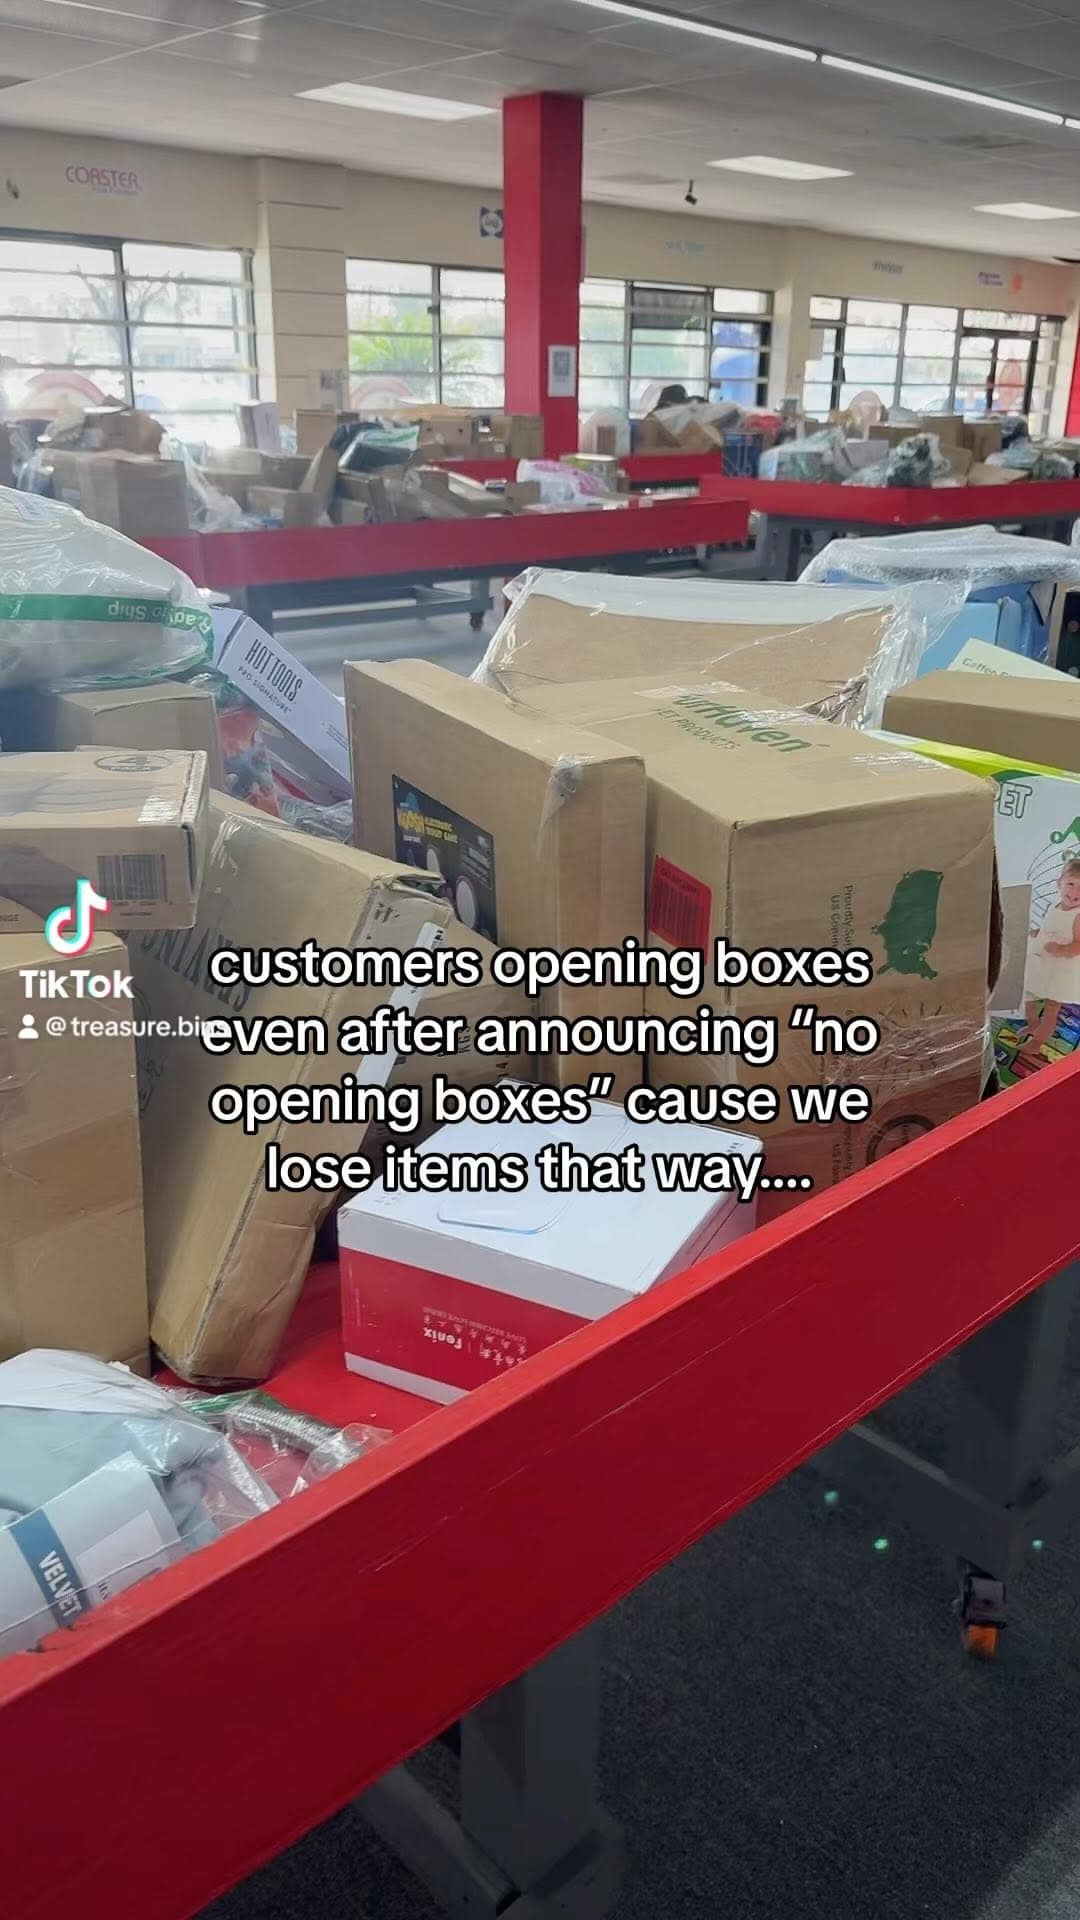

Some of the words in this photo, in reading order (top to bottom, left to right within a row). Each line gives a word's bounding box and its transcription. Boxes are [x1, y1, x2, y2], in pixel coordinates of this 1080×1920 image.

[107, 600, 146, 621] Ship
[244, 638, 275, 675] HOT
[266, 656, 303, 702] TOOLS
[38, 1549, 83, 1617] VELVET
